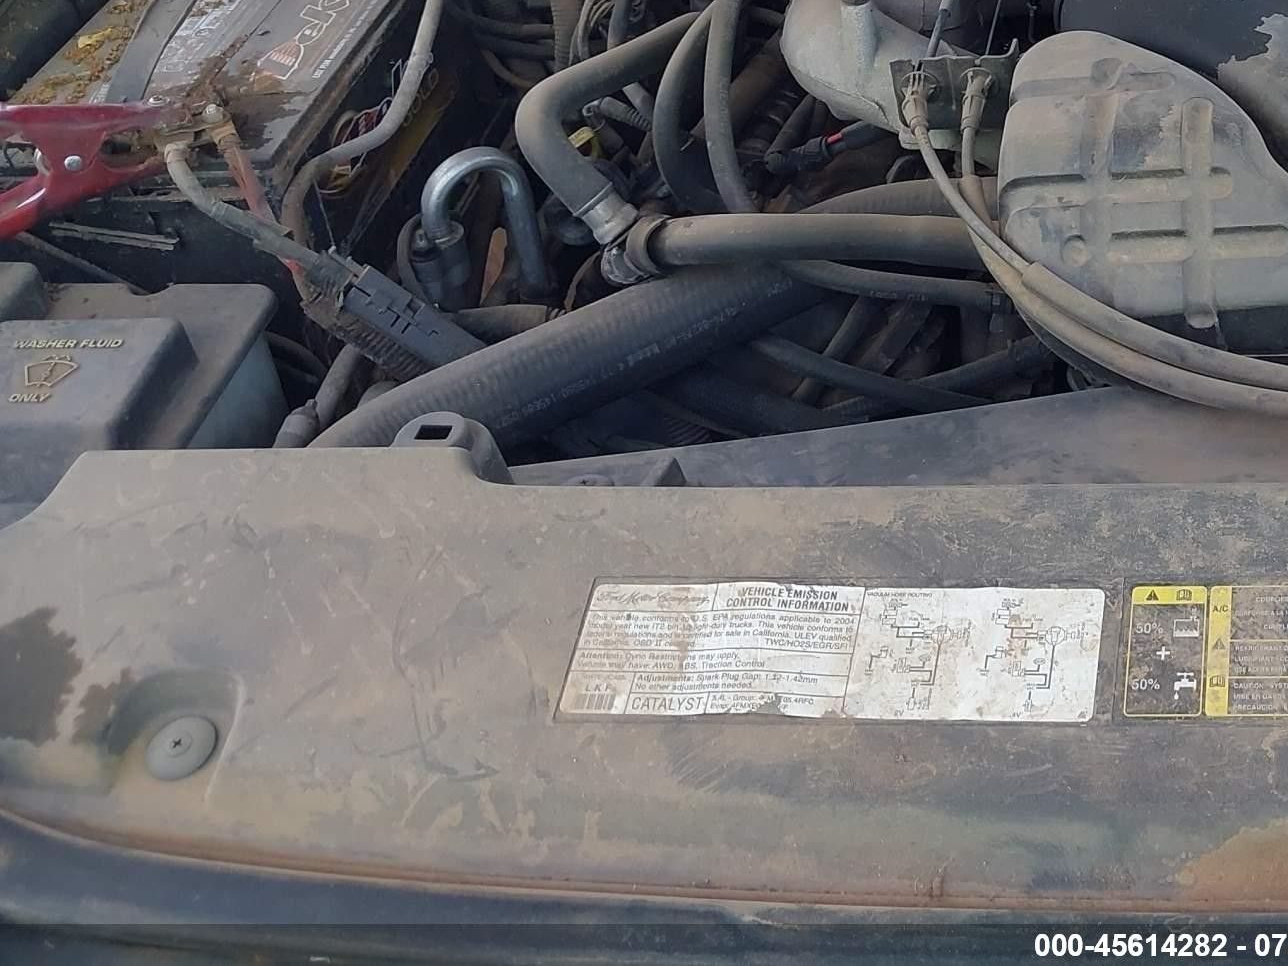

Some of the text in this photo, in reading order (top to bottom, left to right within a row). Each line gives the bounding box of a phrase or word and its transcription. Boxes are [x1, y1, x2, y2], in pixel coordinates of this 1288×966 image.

[14, 338, 123, 348] WASHER FLUID
[8, 393, 51, 402] ONLY
[739, 586, 838, 600] VEHICLE EMISSION
[726, 598, 849, 612] CONTROL INFORMATION
[1212, 605, 1229, 613] A/C
[713, 613, 729, 621] EPA
[731, 613, 776, 622] regulations
[779, 615, 820, 624] applicable
[835, 617, 855, 625] 2004
[758, 621, 775, 629] This
[777, 622, 804, 631] vehicle
[806, 624, 843, 633] conforms
[1135, 622, 1164, 634] 50%
[794, 632, 817, 640] ULEV
[818, 633, 852, 643] qualified
[701, 661, 733, 669] Traction
[735, 660, 766, 668] Control
[696, 674, 719, 683] Spark
[721, 673, 740, 682] Plug
[742, 673, 761, 682] Gap:
[635, 682, 646, 690] No
[671, 682, 719, 691] adjustments
[1131, 678, 1161, 690] 50%
[631, 696, 704, 711] CATALYST
